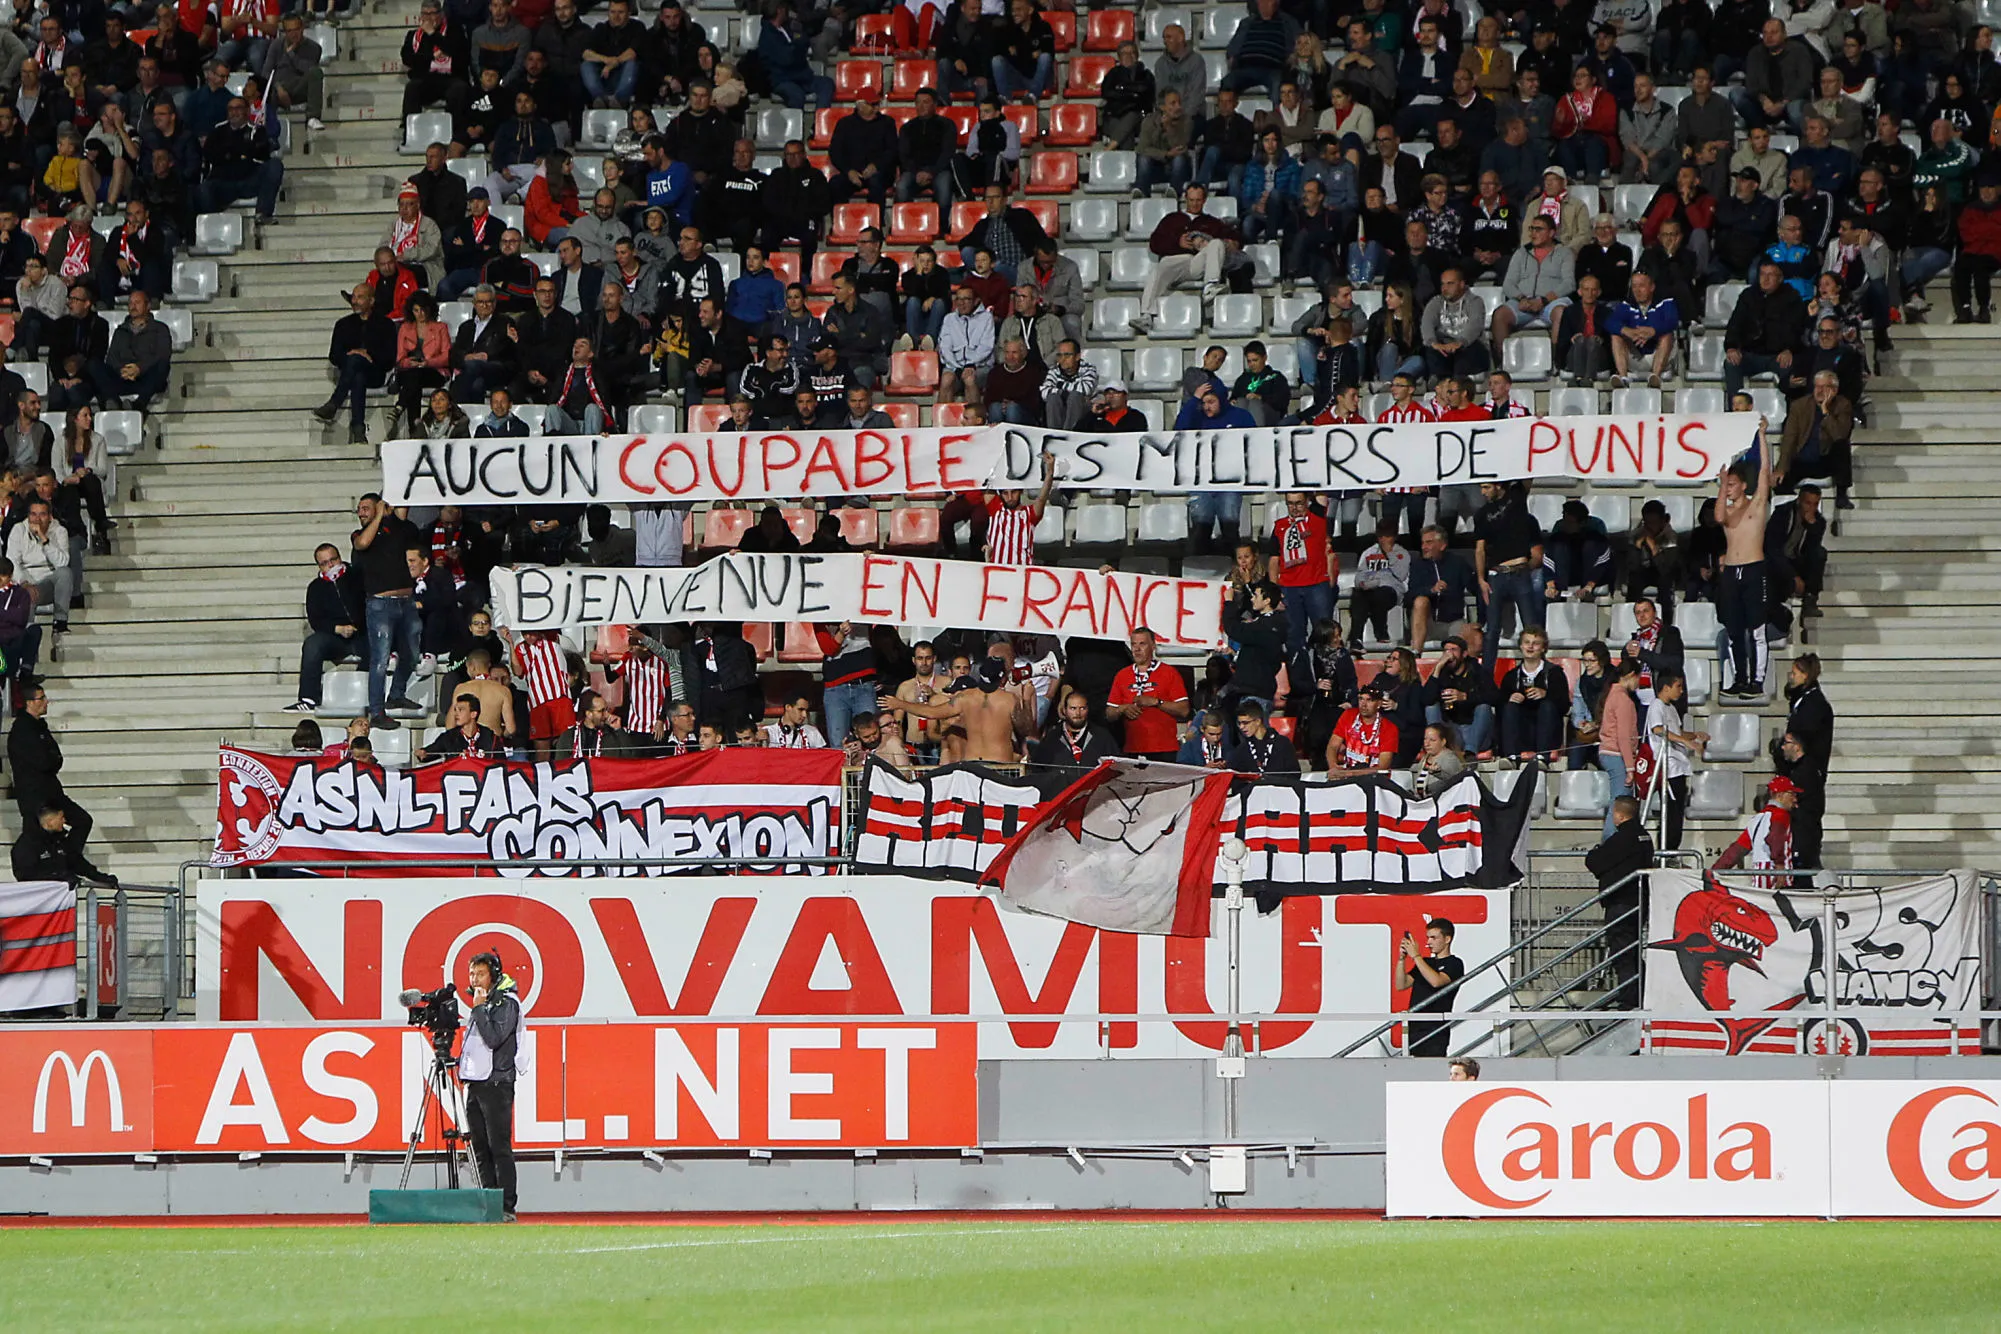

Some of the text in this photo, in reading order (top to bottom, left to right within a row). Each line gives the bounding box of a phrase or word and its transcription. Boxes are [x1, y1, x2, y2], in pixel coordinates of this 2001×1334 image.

[403, 439, 599, 500] AUCUN
[619, 434, 977, 498] COUPABLE
[1005, 429, 1109, 483] DES
[1434, 427, 1498, 480] DE
[860, 557, 942, 621] EN
[222, 753, 277, 798] CONNEXION
[277, 760, 596, 834] ASNL FANS
[491, 798, 828, 879] CONNEXION
[219, 895, 1489, 1055] NOVAMUT
[195, 1028, 938, 1146] ASNL.NET
[1441, 1087, 1772, 1210] Carola
